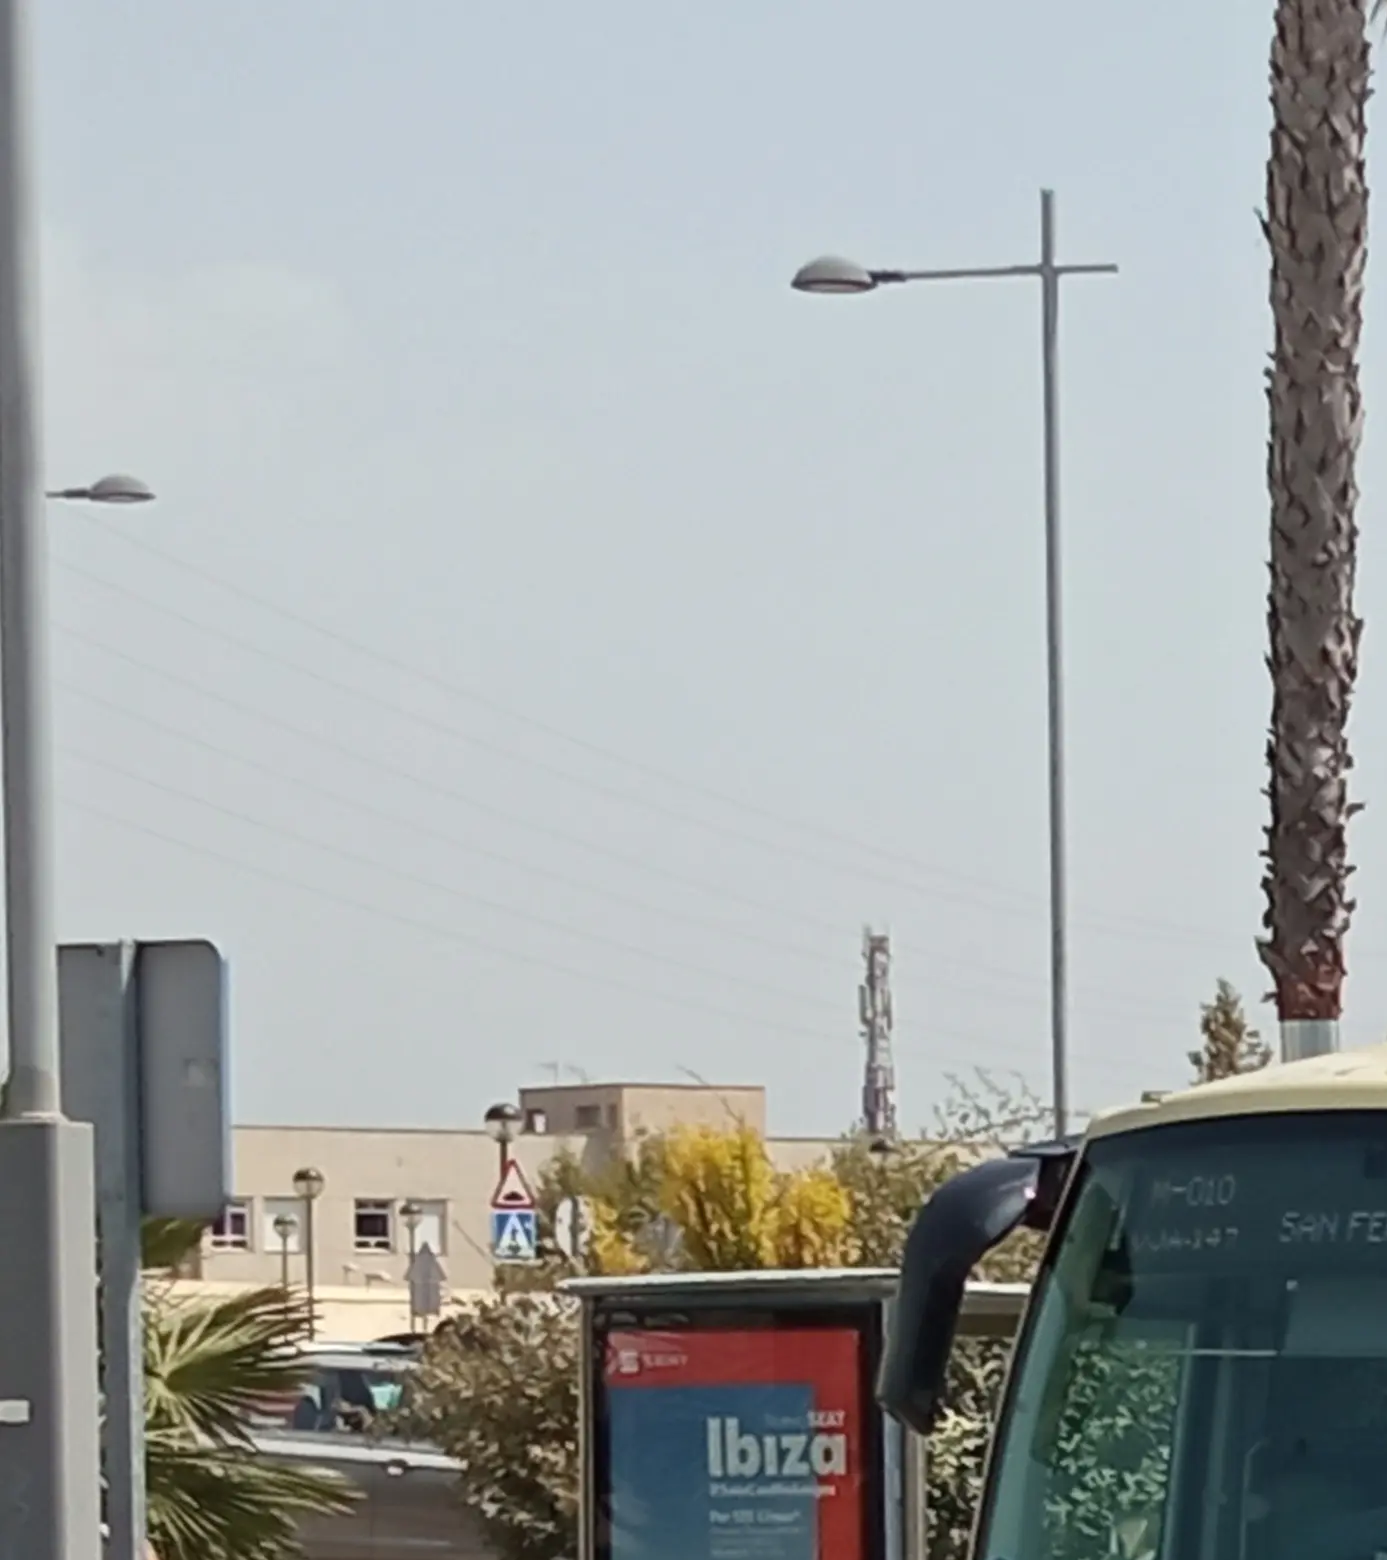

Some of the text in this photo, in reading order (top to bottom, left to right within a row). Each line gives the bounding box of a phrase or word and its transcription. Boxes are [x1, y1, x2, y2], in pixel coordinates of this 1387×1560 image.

[1279, 1211, 1339, 1243] SAN
[807, 1410, 846, 1429] SEAT
[707, 1416, 848, 1478] Ibiza
